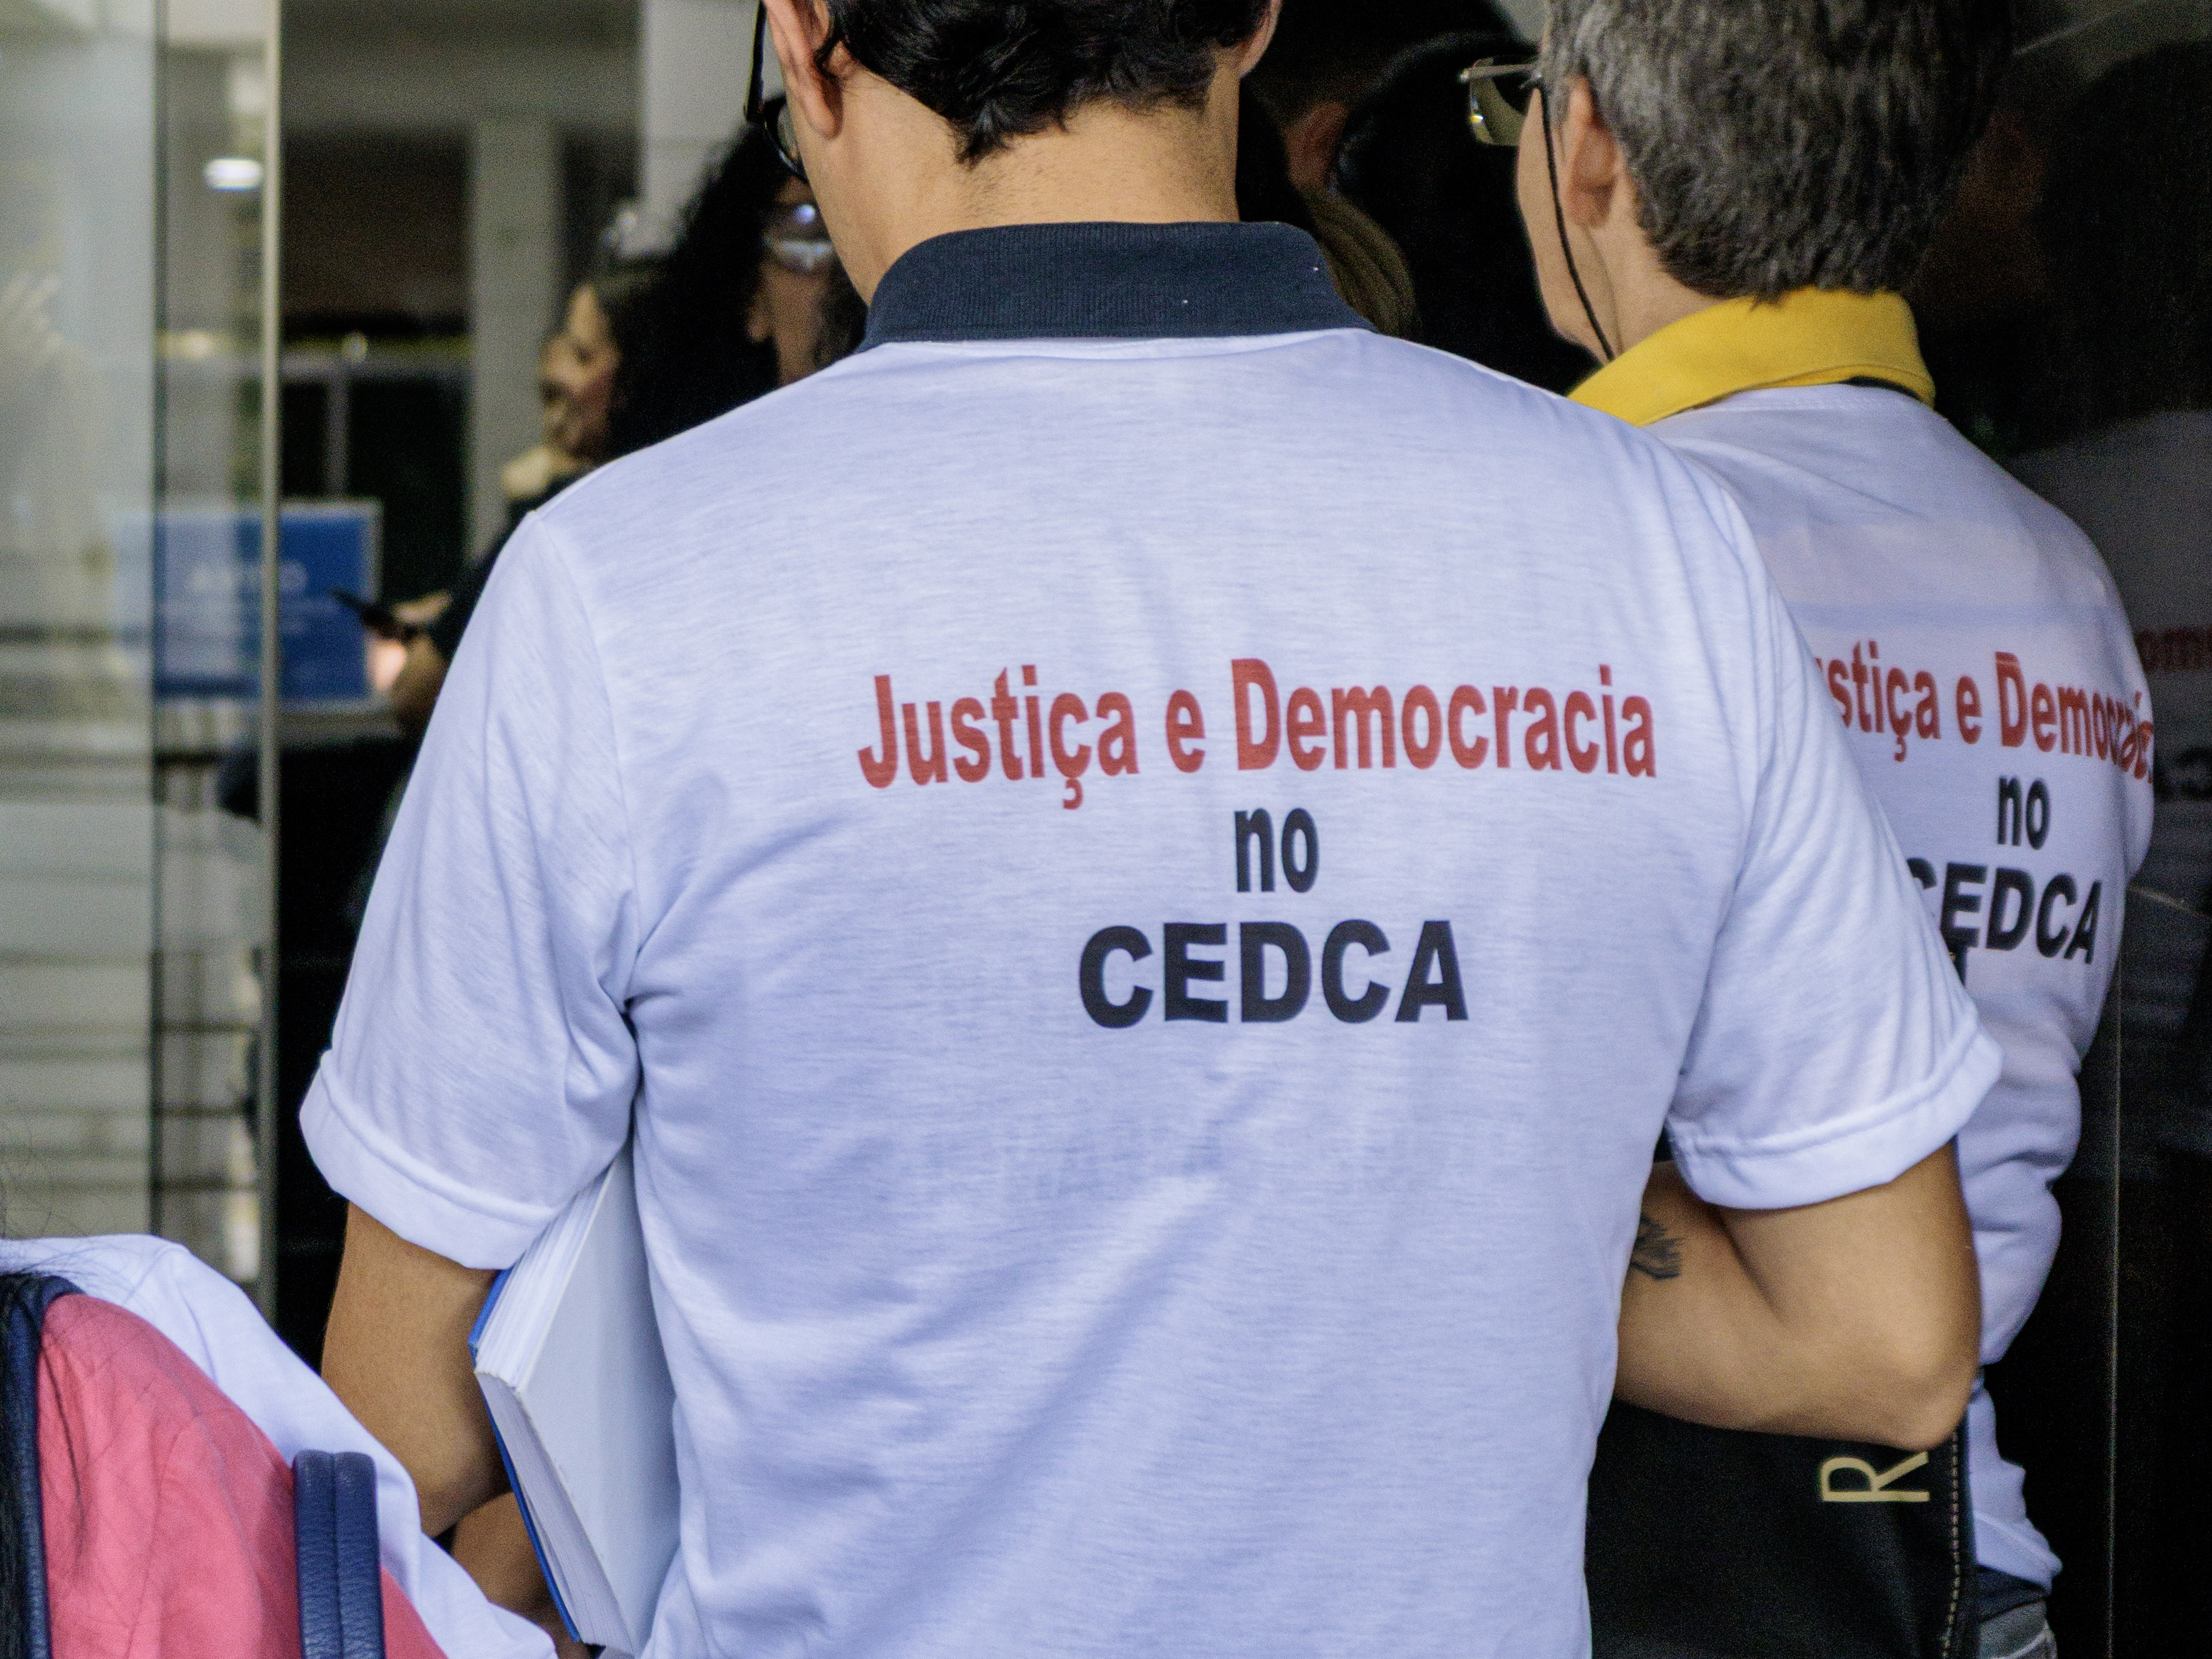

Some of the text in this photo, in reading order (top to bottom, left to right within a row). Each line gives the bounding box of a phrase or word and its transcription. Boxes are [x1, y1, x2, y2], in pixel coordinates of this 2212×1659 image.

[857, 658, 1657, 810] Justiça e Democracia
[1815, 640, 1941, 762] stiça
[1956, 675, 1982, 744] e
[1234, 808, 1319, 893] no
[1997, 775, 2051, 850] no
[1079, 919, 1468, 1029] CEDCA
